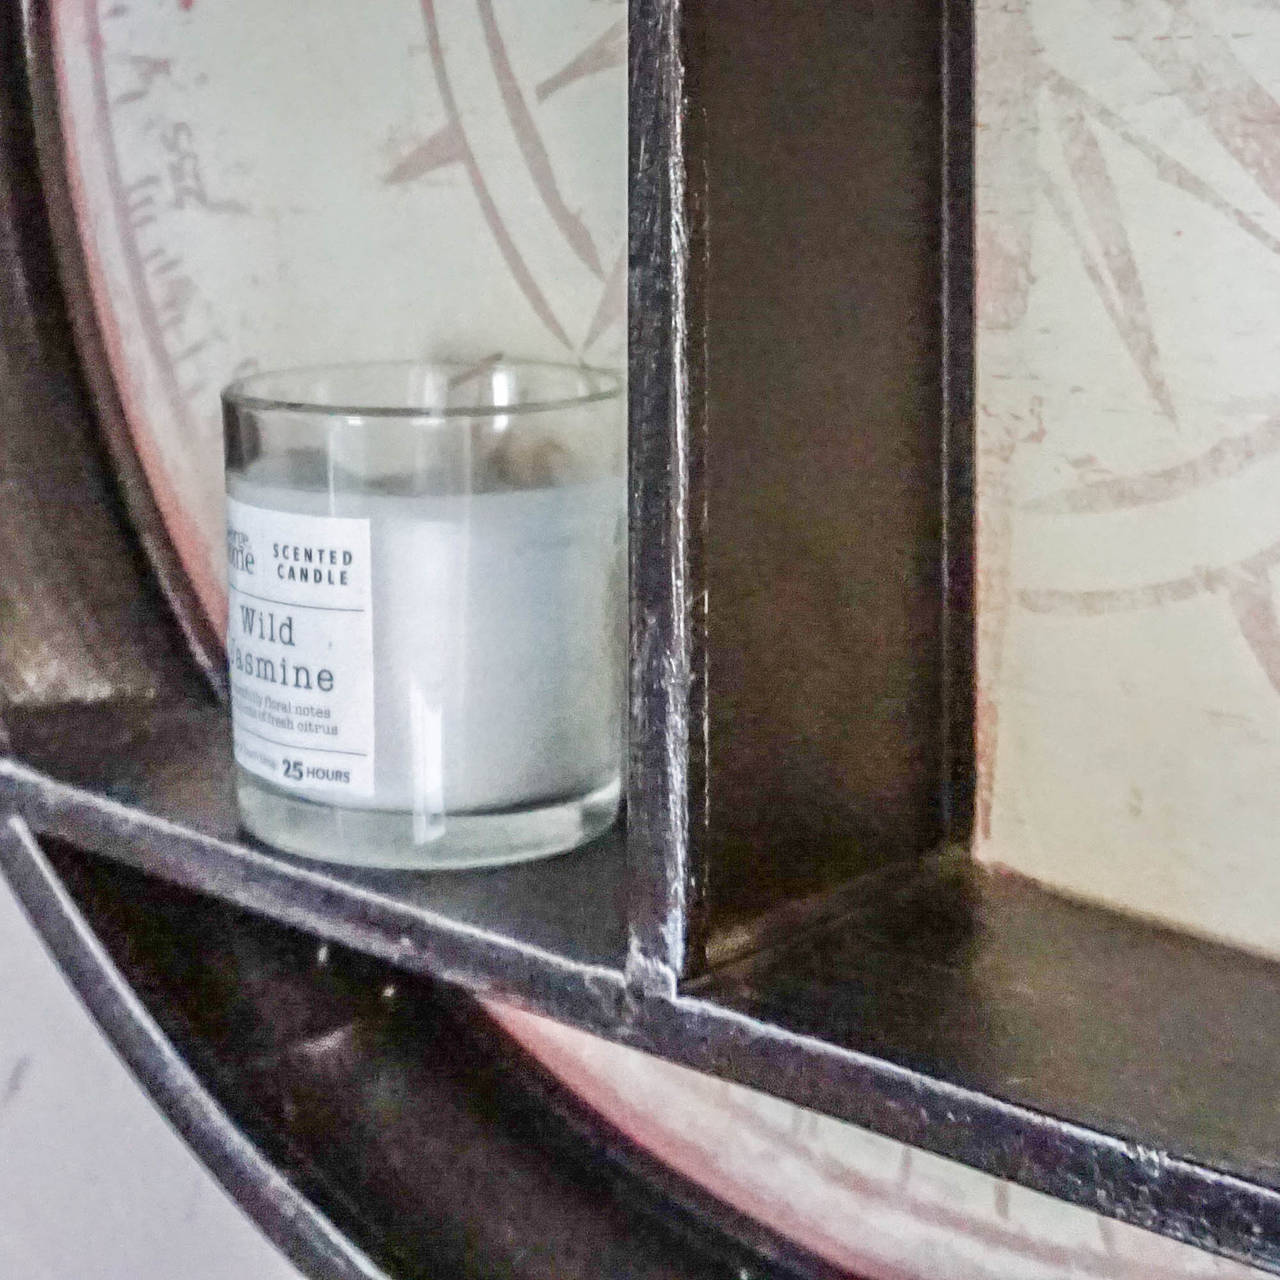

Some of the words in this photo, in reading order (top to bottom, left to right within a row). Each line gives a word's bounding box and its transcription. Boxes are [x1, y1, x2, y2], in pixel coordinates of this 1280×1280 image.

[273, 542, 353, 566] SCENTED
[277, 562, 349, 586] CANDLE
[240, 605, 296, 648] Wild
[295, 704, 332, 720] notes
[282, 758, 304, 782] 25
[306, 767, 351, 785] HOURS
